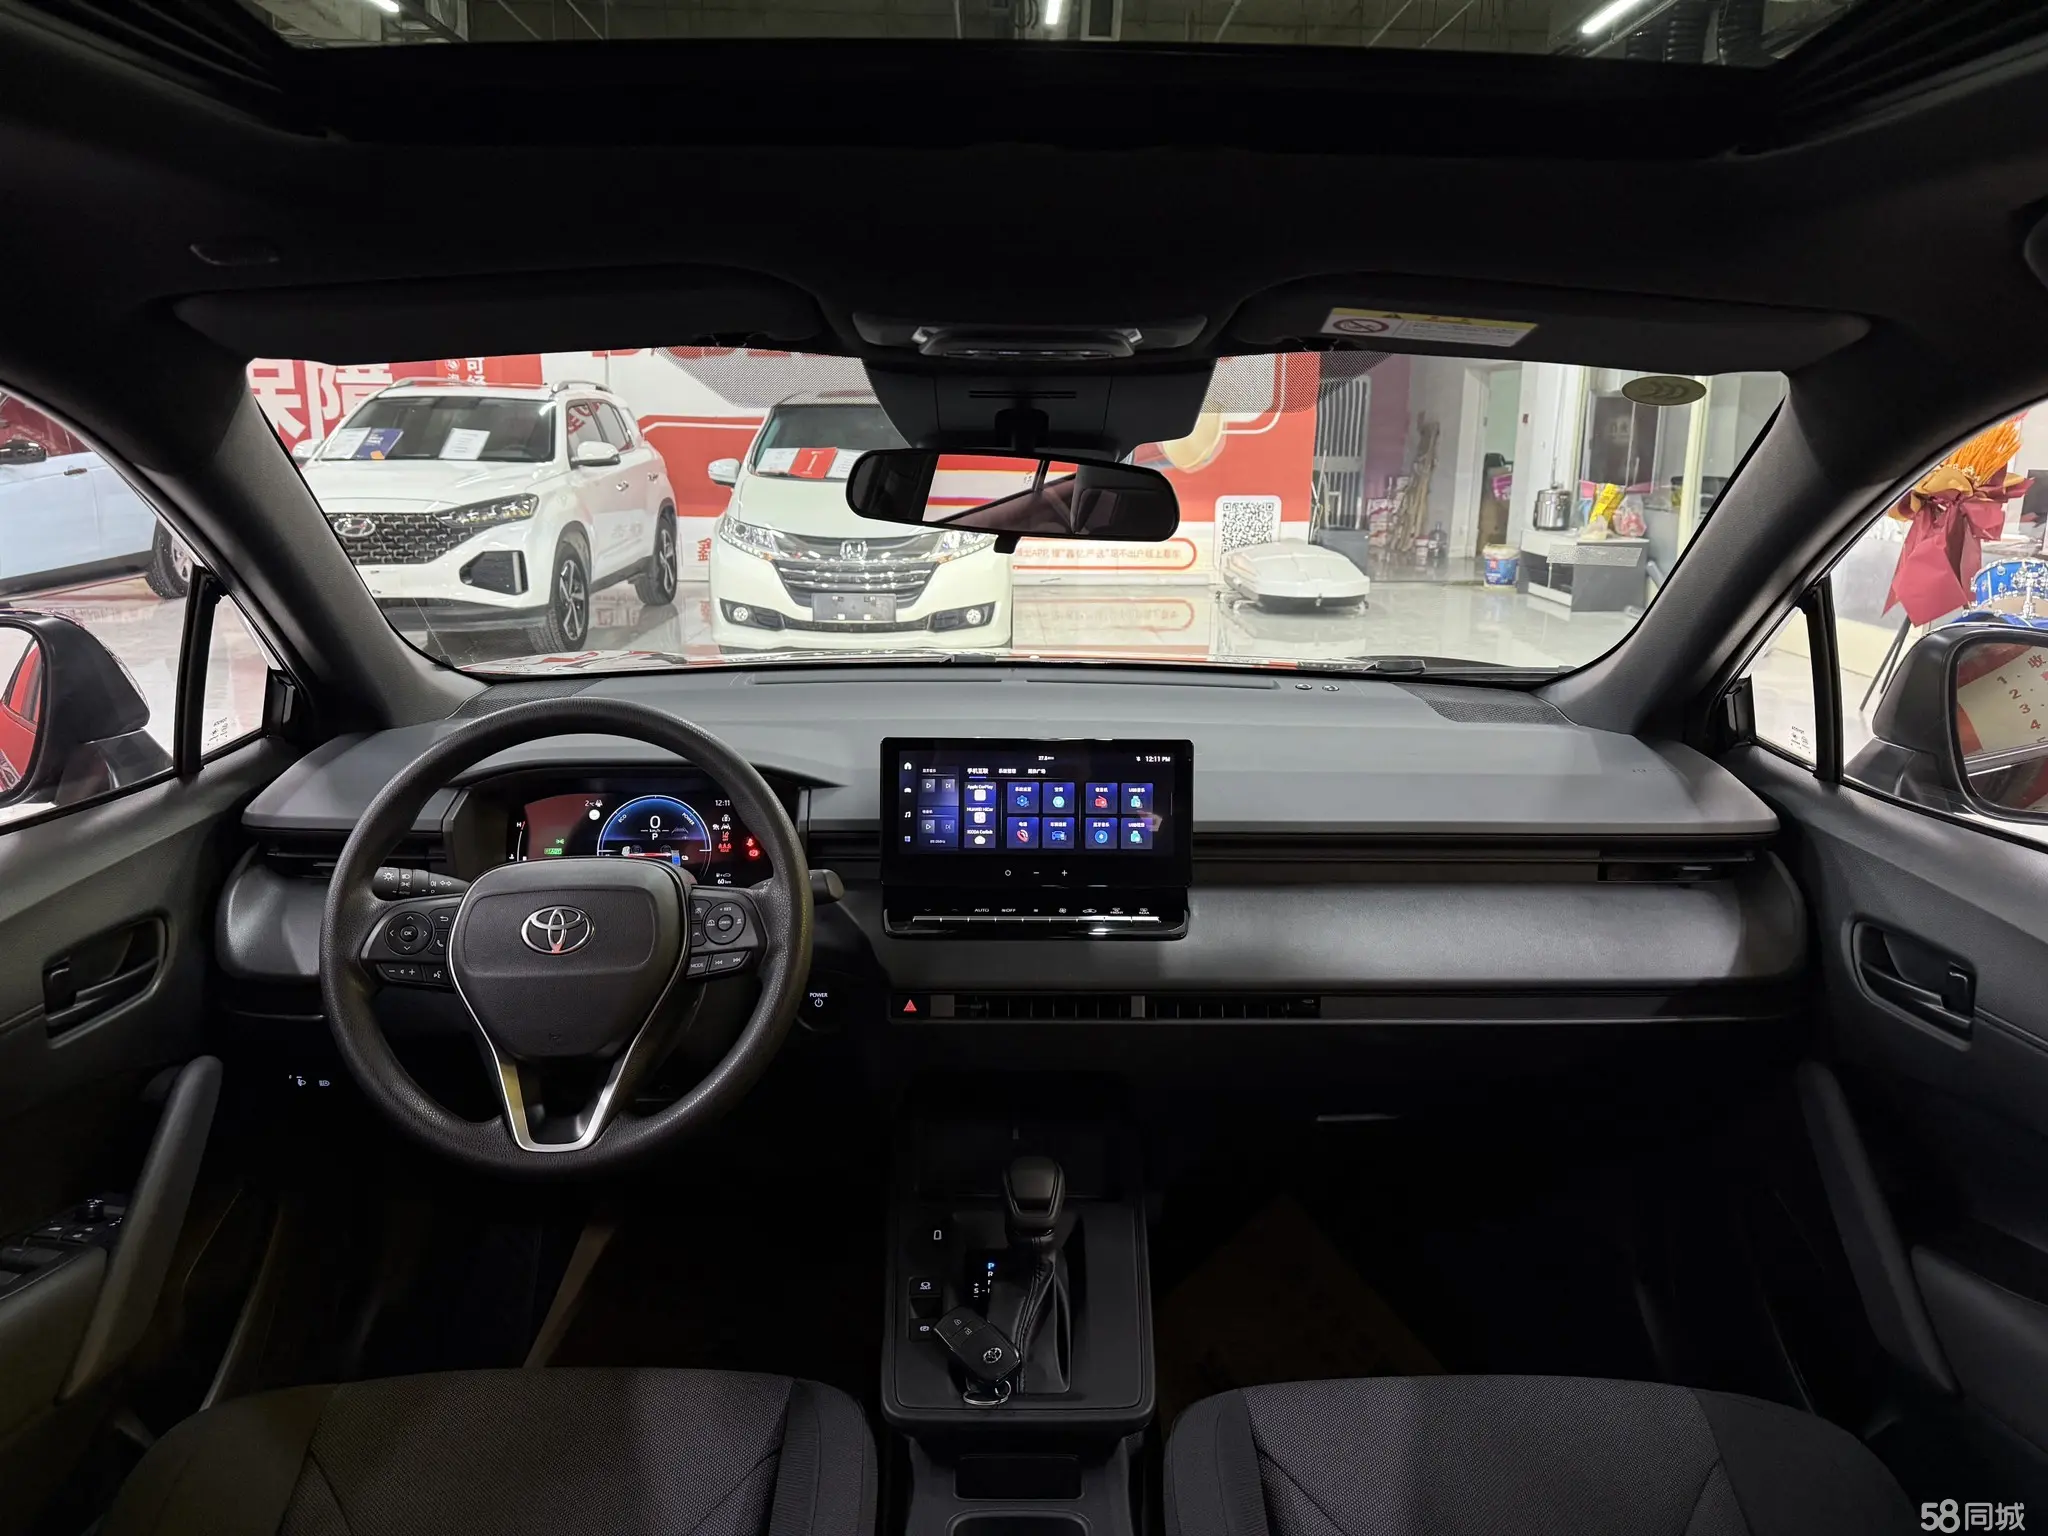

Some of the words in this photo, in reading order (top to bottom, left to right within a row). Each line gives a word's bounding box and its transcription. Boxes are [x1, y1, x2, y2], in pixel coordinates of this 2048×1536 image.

[2008, 688, 2022, 699] 2
[2019, 703, 2031, 714] 3
[2030, 718, 2041, 730] 4
[650, 816, 661, 829] 0
